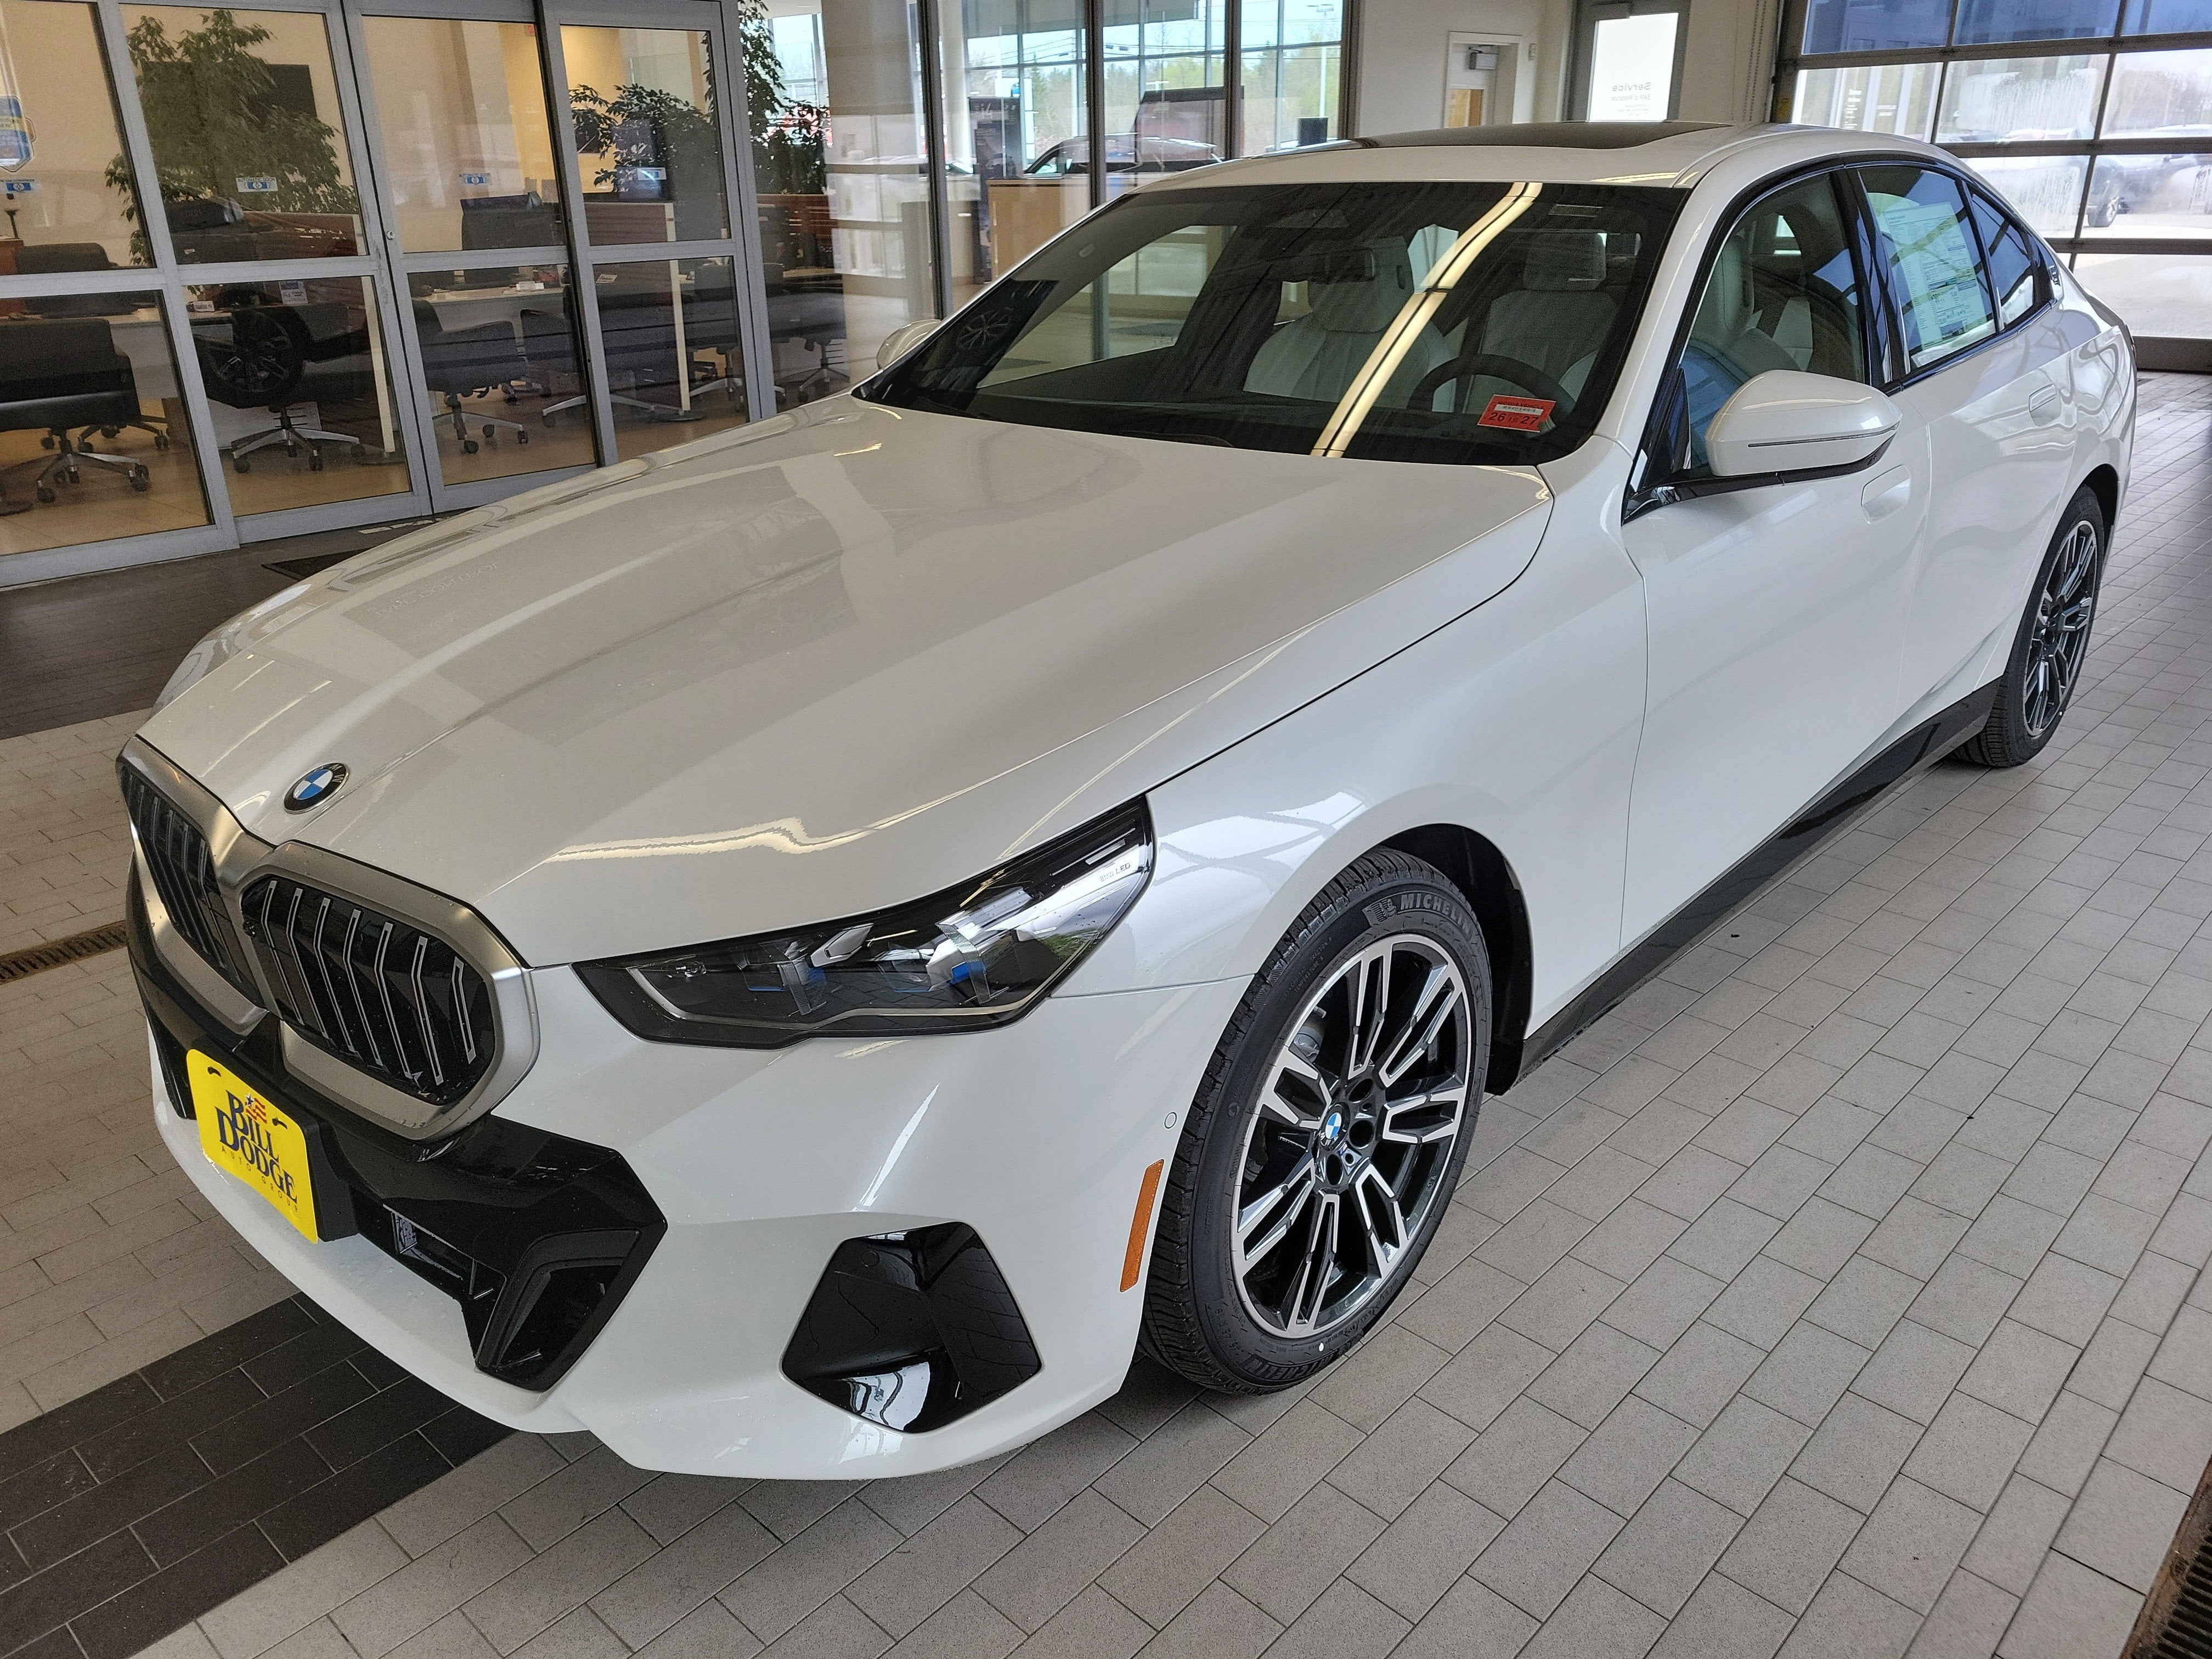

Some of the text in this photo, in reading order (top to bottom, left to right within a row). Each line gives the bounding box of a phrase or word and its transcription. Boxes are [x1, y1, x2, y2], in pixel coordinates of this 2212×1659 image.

[1488, 412, 1506, 421] 26
[1519, 416, 1539, 425] 27
[1099, 862, 1131, 882] BMW LED
[1400, 894, 1472, 935] MICHELIN
[225, 1090, 279, 1160] BILL
[214, 1106, 297, 1204] DODGE
[222, 1146, 297, 1212] AUTO GROUP
[1244, 1353, 1335, 1379] MICHELIN
